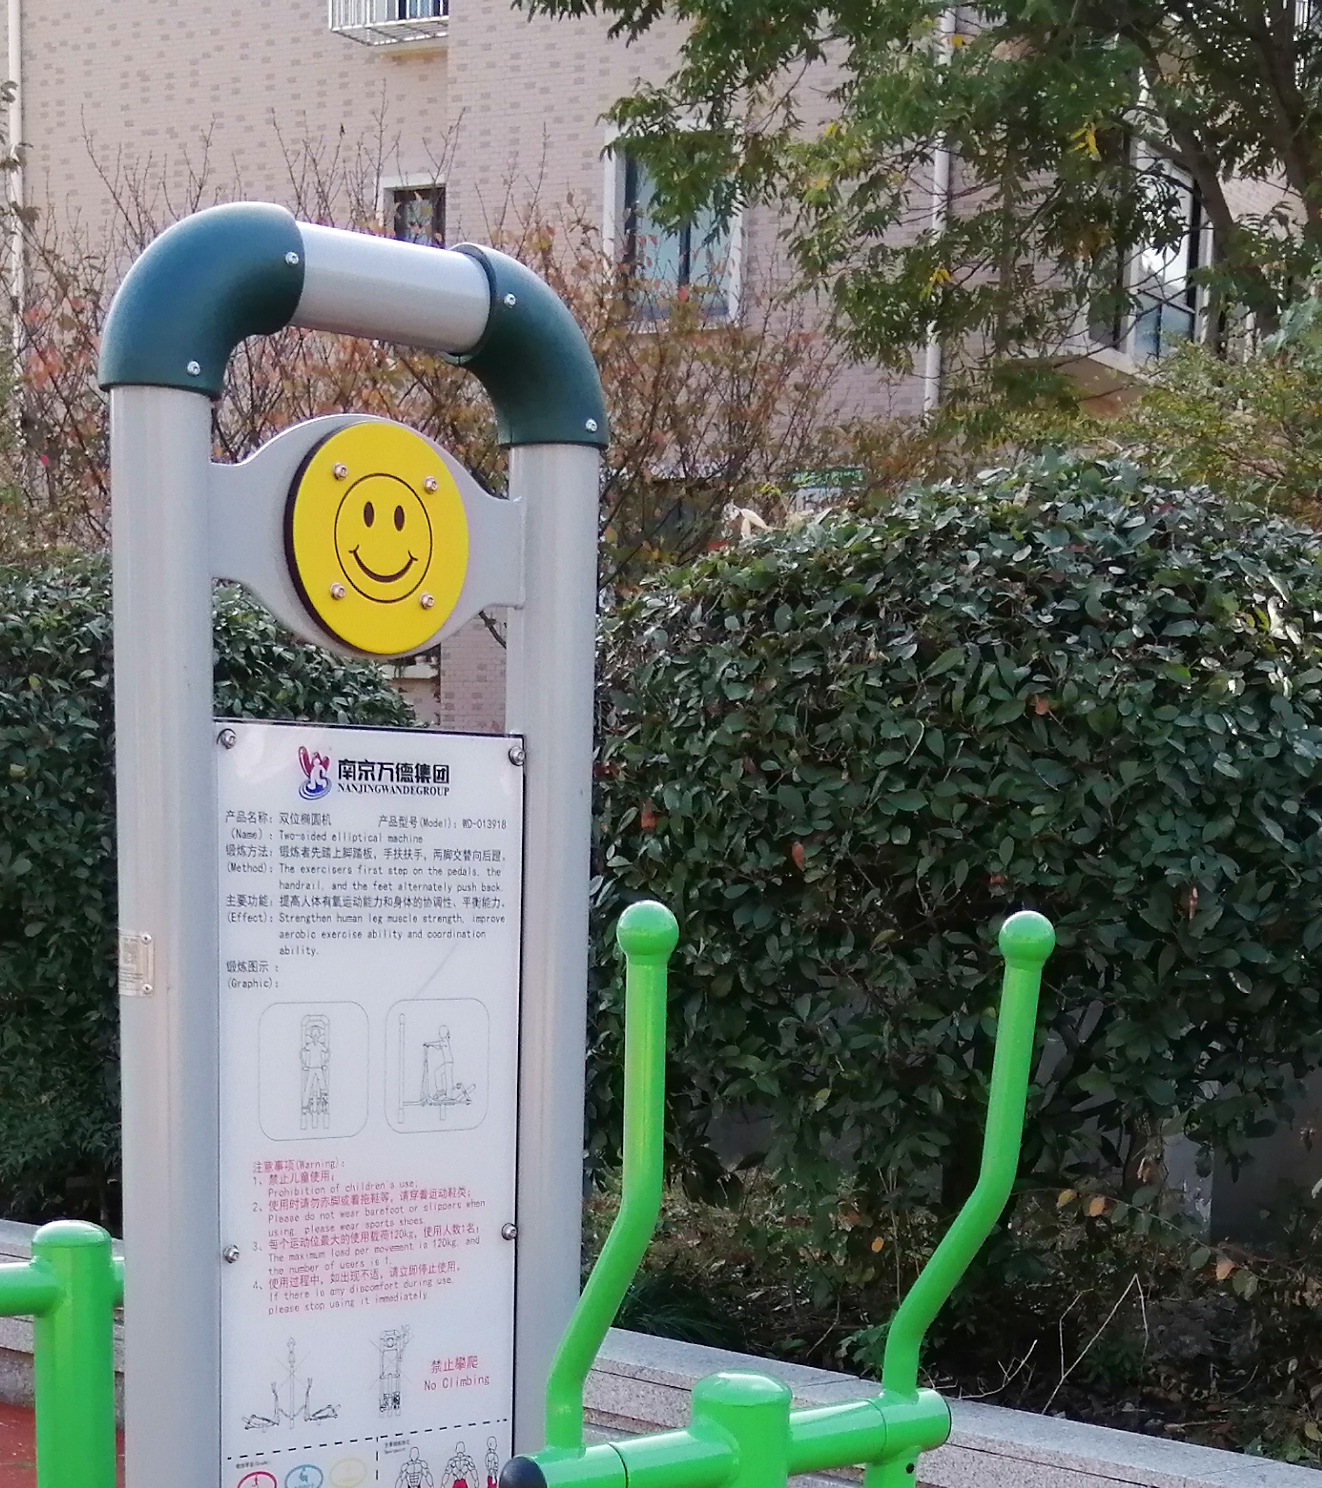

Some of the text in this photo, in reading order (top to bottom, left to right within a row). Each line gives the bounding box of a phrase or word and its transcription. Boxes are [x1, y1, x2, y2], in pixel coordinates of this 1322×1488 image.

[337, 758, 450, 784] 南京万德集团
[337, 783, 450, 797] NANJINGWANDEGROUP
[279, 829, 327, 841] Two-sided
[331, 831, 383, 843] elliptical
[387, 833, 424, 844] machine
[279, 862, 296, 873] The
[300, 863, 353, 874] exercisers
[357, 864, 383, 875] first
[388, 865, 409, 876] step
[412, 867, 424, 875] on
[428, 866, 443, 876] the
[487, 867, 502, 877] the
[331, 880, 348, 891] and
[352, 880, 368, 891] the
[373, 881, 393, 892] feet
[397, 882, 453, 894] alternately
[457, 882, 477, 893] push
[279, 912, 332, 925] Strengthen
[336, 912, 363, 923] human
[368, 913, 383, 925] leg
[387, 913, 418, 923] muscle
[472, 914, 506, 925] improve
[279, 928, 486, 940] aerobic exercise ability and coordination
[279, 945, 319, 957] ability.
[268, 1184, 326, 1198] Prohibition
[330, 1183, 340, 1193] of
[268, 1198, 486, 1224] Please do not wear barefoot or slippers when
[304, 1223, 336, 1236] please
[340, 1222, 359, 1231] wear
[365, 1219, 395, 1232] sports
[268, 1252, 284, 1263] The
[288, 1250, 326, 1262] maximum
[331, 1247, 351, 1258] load
[354, 1247, 369, 1258] per
[374, 1242, 414, 1254] movement
[419, 1241, 429, 1249] is
[465, 1236, 480, 1246] and
[268, 1265, 284, 1275] the
[289, 1262, 319, 1274] number
[325, 1261, 335, 1271] of
[340, 1260, 365, 1270] users
[370, 1257, 380, 1266] is
[269, 1292, 279, 1302] If
[284, 1290, 310, 1301] there
[316, 1289, 325, 1297] is
[330, 1286, 345, 1297] any
[349, 1280, 399, 1294] discomfort
[403, 1277, 433, 1289] during
[268, 1304, 300, 1316] please
[304, 1301, 325, 1311] stop
[329, 1299, 355, 1309] using
[360, 1297, 370, 1305] it
[424, 1374, 491, 1391] No Climbing
